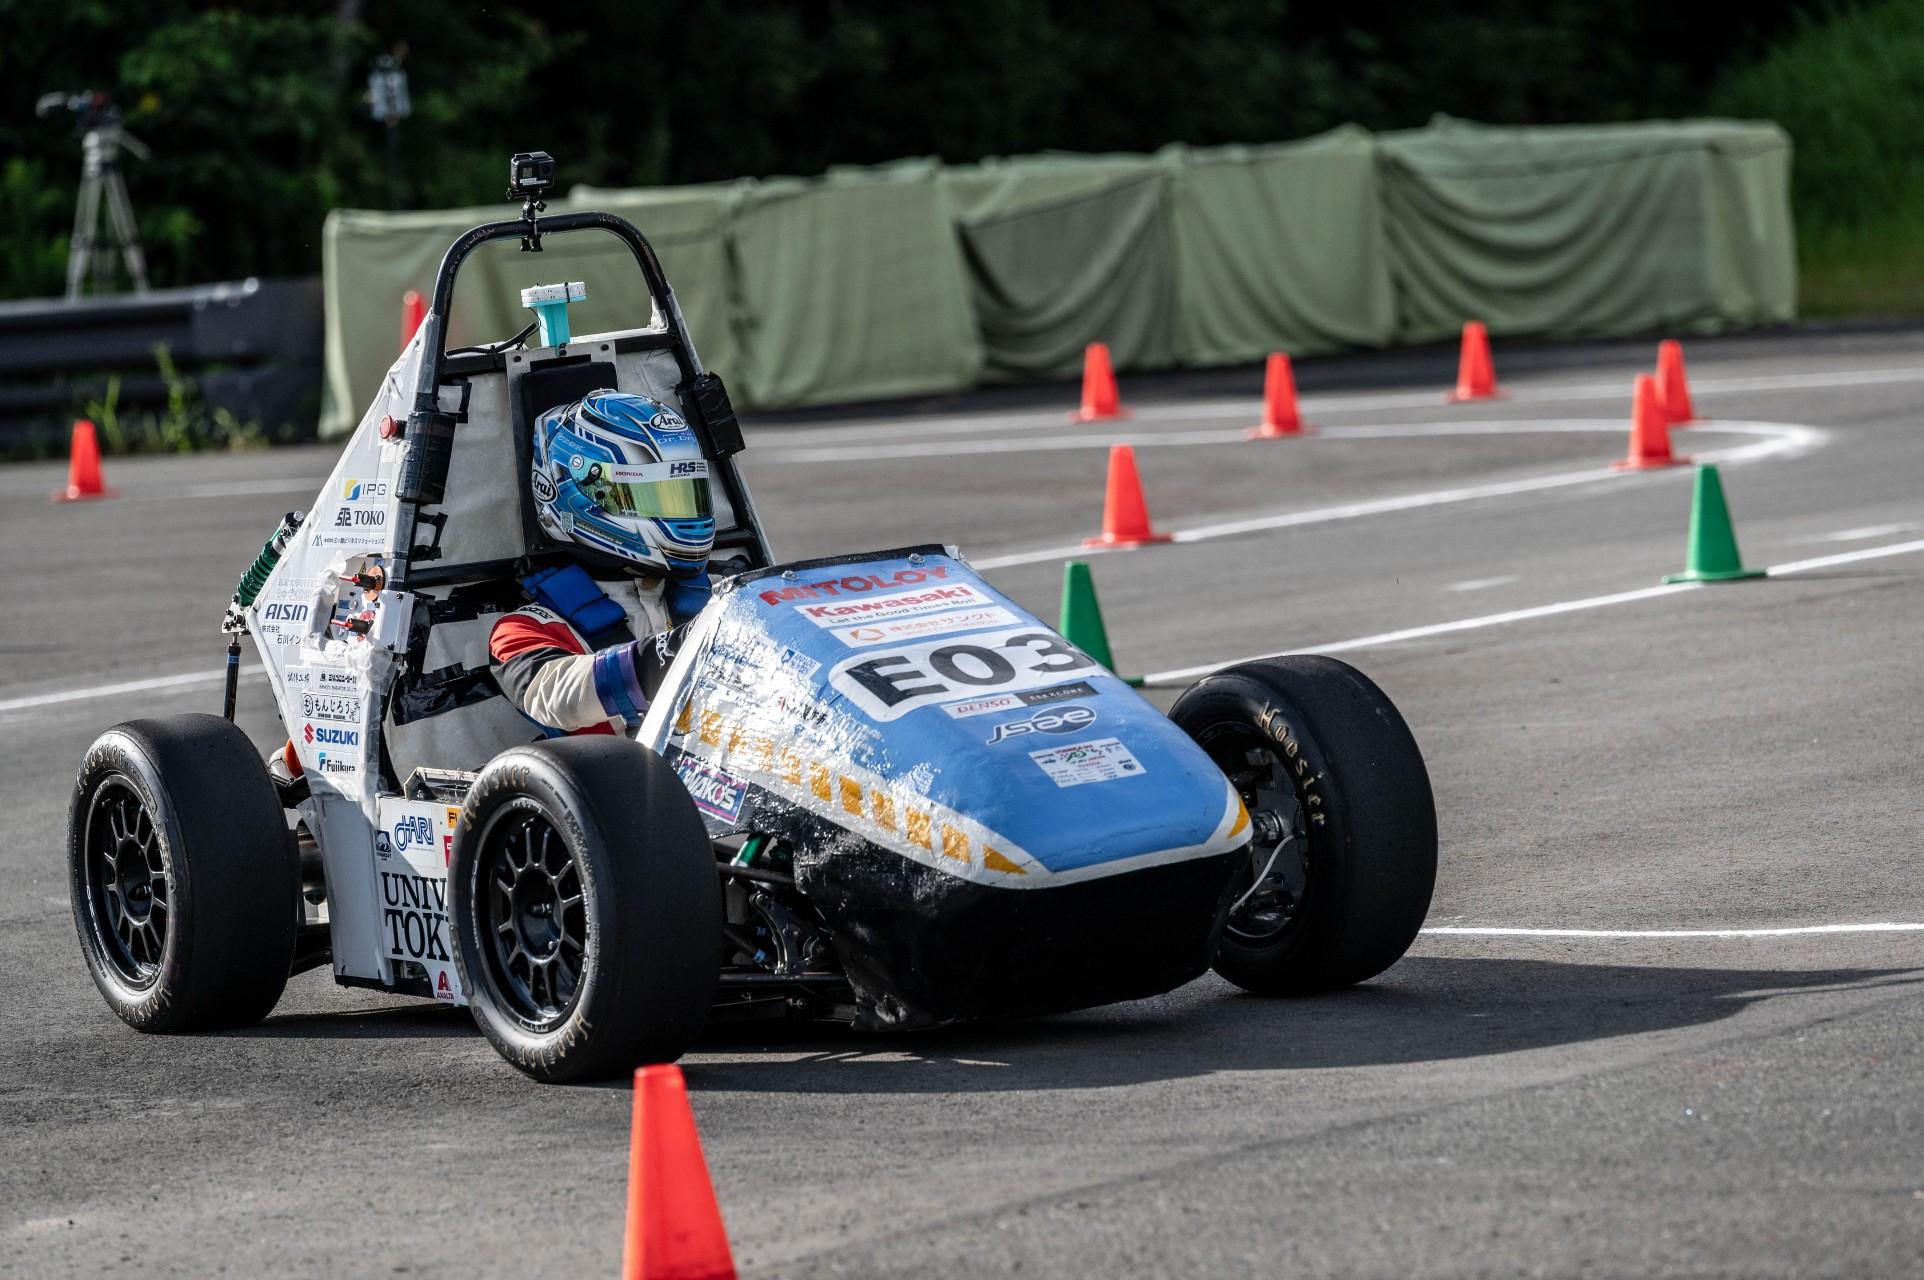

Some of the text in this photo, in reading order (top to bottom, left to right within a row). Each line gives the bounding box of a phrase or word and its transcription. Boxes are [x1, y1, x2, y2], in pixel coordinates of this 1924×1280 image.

[670, 461, 696, 474] HRS
[362, 483, 387, 496] IPG
[532, 472, 553, 497] Arai
[354, 510, 385, 526] TOKO
[759, 566, 949, 606] MITOLOY
[806, 587, 973, 617] Kawasaki
[265, 604, 309, 621] AISIN
[829, 598, 976, 624] Let the Good Times Roll
[846, 633, 1096, 708] E03
[315, 698, 350, 714] もんじろう
[957, 698, 1011, 714] DENSO
[316, 728, 359, 745] SUZUKI
[326, 759, 356, 774] Fujikura
[385, 908, 450, 962] TOK
